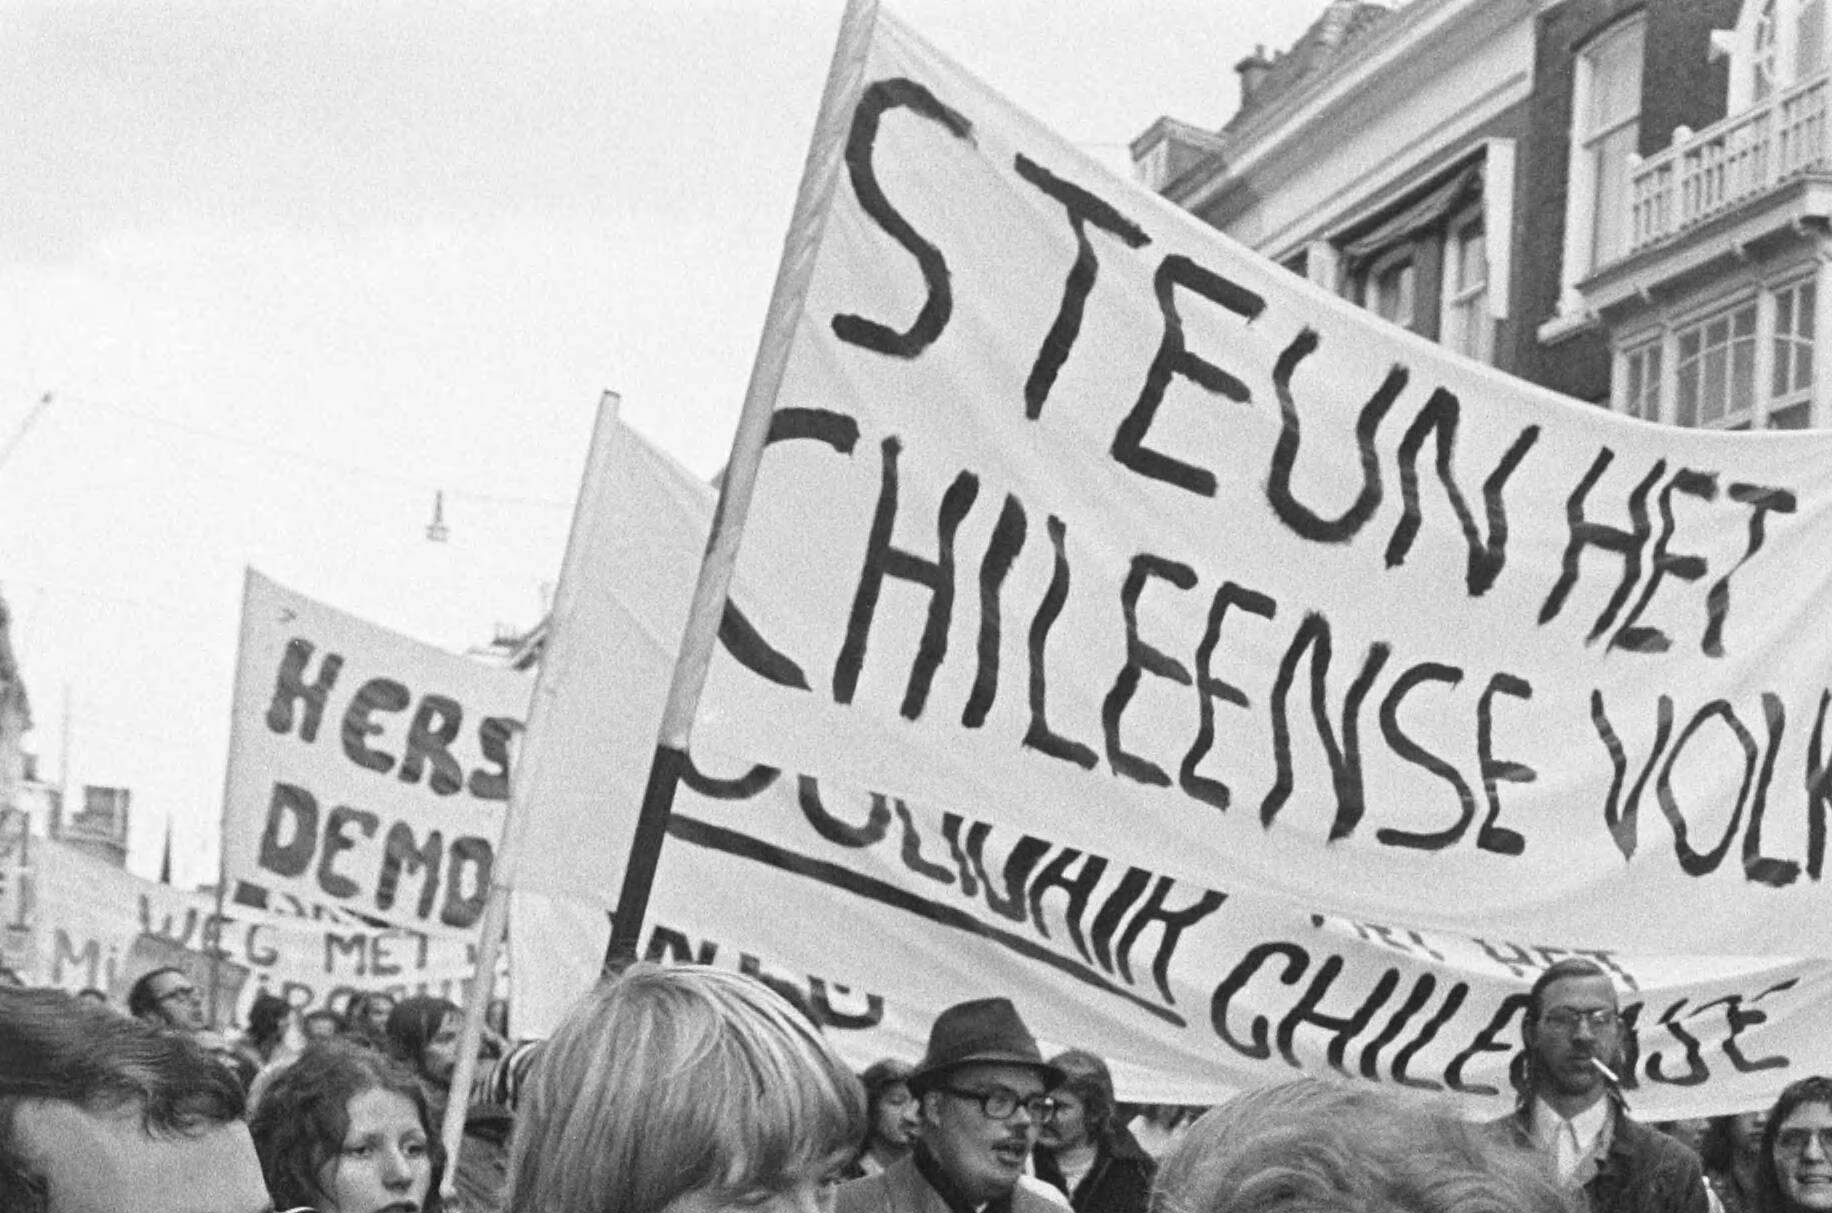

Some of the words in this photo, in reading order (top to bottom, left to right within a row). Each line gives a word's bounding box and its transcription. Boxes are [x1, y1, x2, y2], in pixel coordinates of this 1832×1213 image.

[830, 76, 1541, 598] STEUN
[1537, 445, 1798, 660] HET
[716, 406, 1540, 857] CHILEENSE
[265, 637, 526, 802] HERS
[257, 780, 496, 930] DEMO
[324, 930, 430, 976] MET
